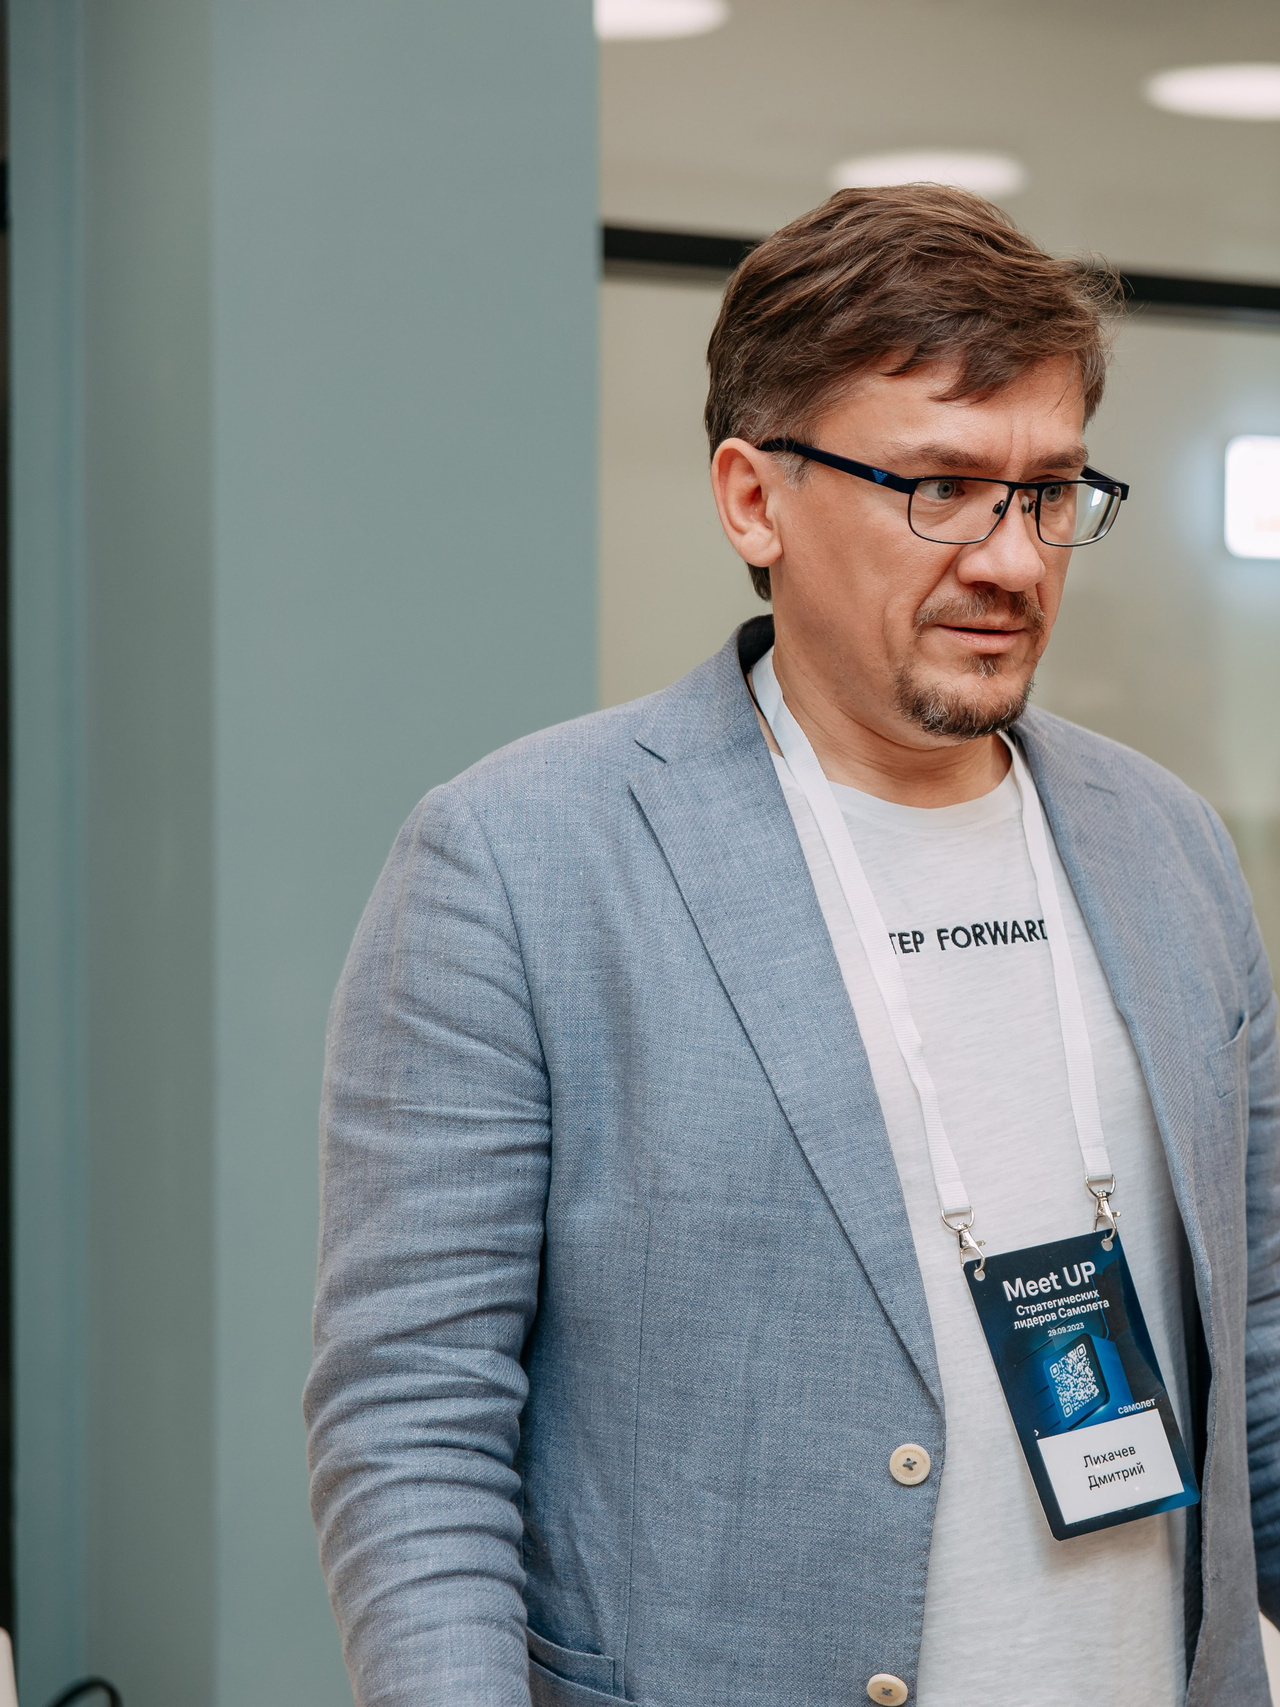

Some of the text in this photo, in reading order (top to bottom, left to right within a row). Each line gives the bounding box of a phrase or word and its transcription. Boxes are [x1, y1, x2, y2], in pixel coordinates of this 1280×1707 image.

[888, 930, 925, 955] TEP
[1002, 1261, 1096, 1302] Meet UP
[1013, 1299, 1110, 1329] лидеров Самолета
[1016, 1289, 1100, 1316] Стратегических
[1047, 1322, 1085, 1337] 29.09.2023
[1117, 1398, 1156, 1414] самолет
[1083, 1446, 1136, 1468] Лихачев
[1088, 1461, 1146, 1490] Дмитрий
